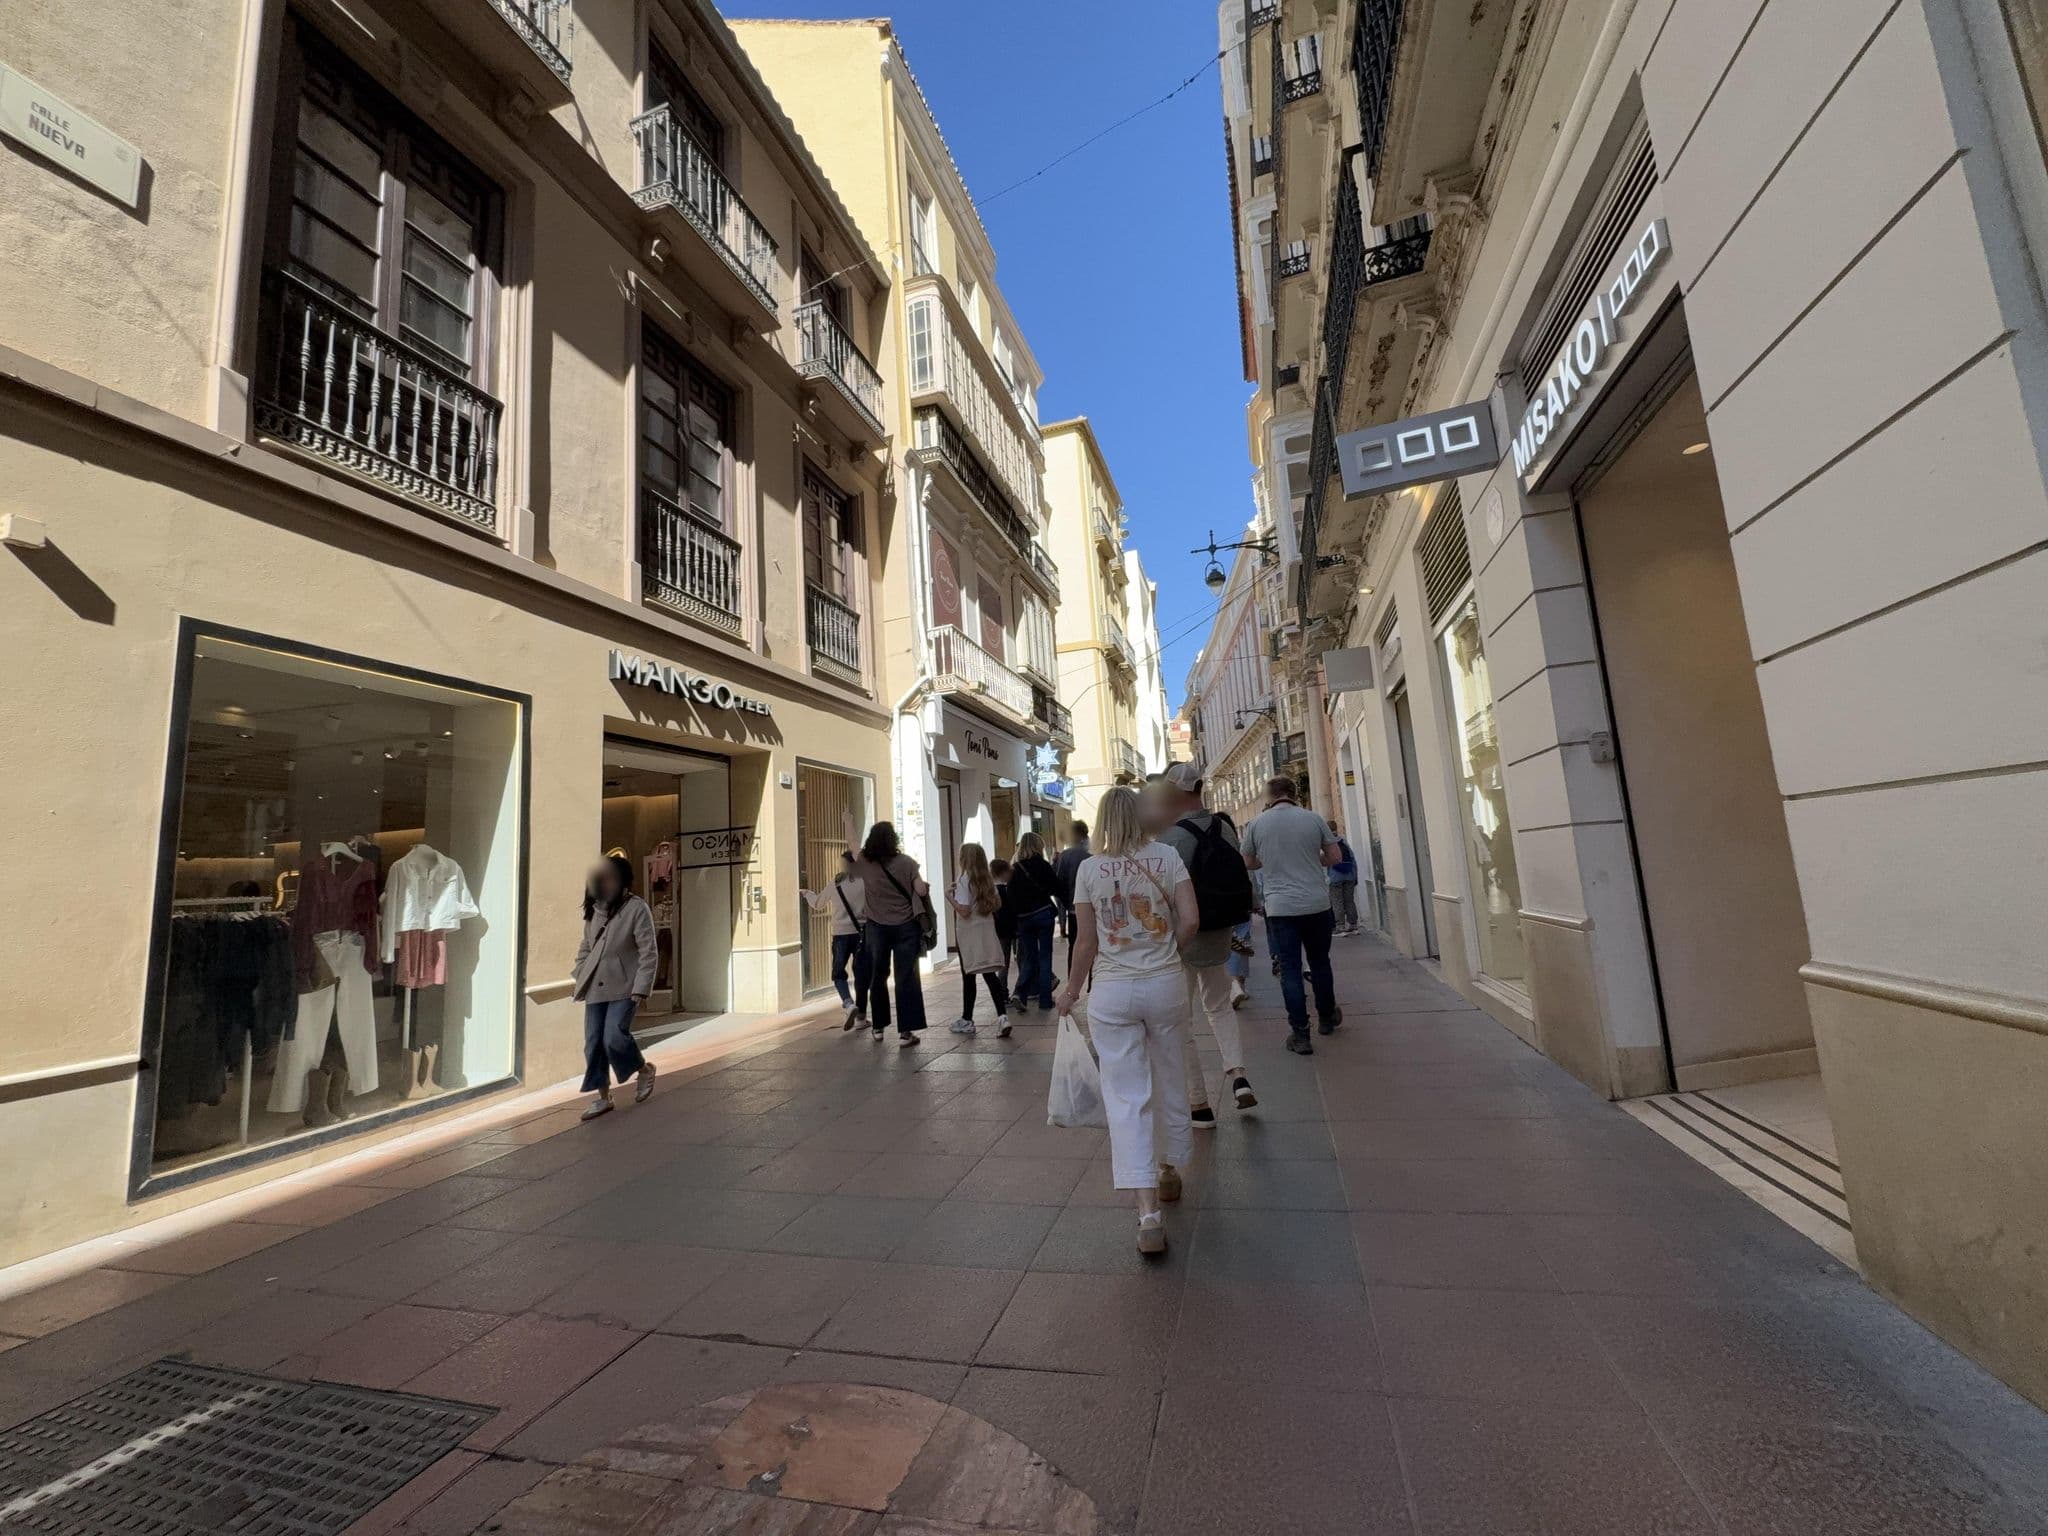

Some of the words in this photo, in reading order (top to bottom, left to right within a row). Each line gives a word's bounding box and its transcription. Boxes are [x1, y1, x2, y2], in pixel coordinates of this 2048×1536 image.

[28, 113, 86, 160] NUEVA
[30, 101, 71, 132] CALLE
[1511, 319, 1597, 479] MISAKO
[609, 648, 734, 710] MANGO
[738, 695, 774, 716] TEEN
